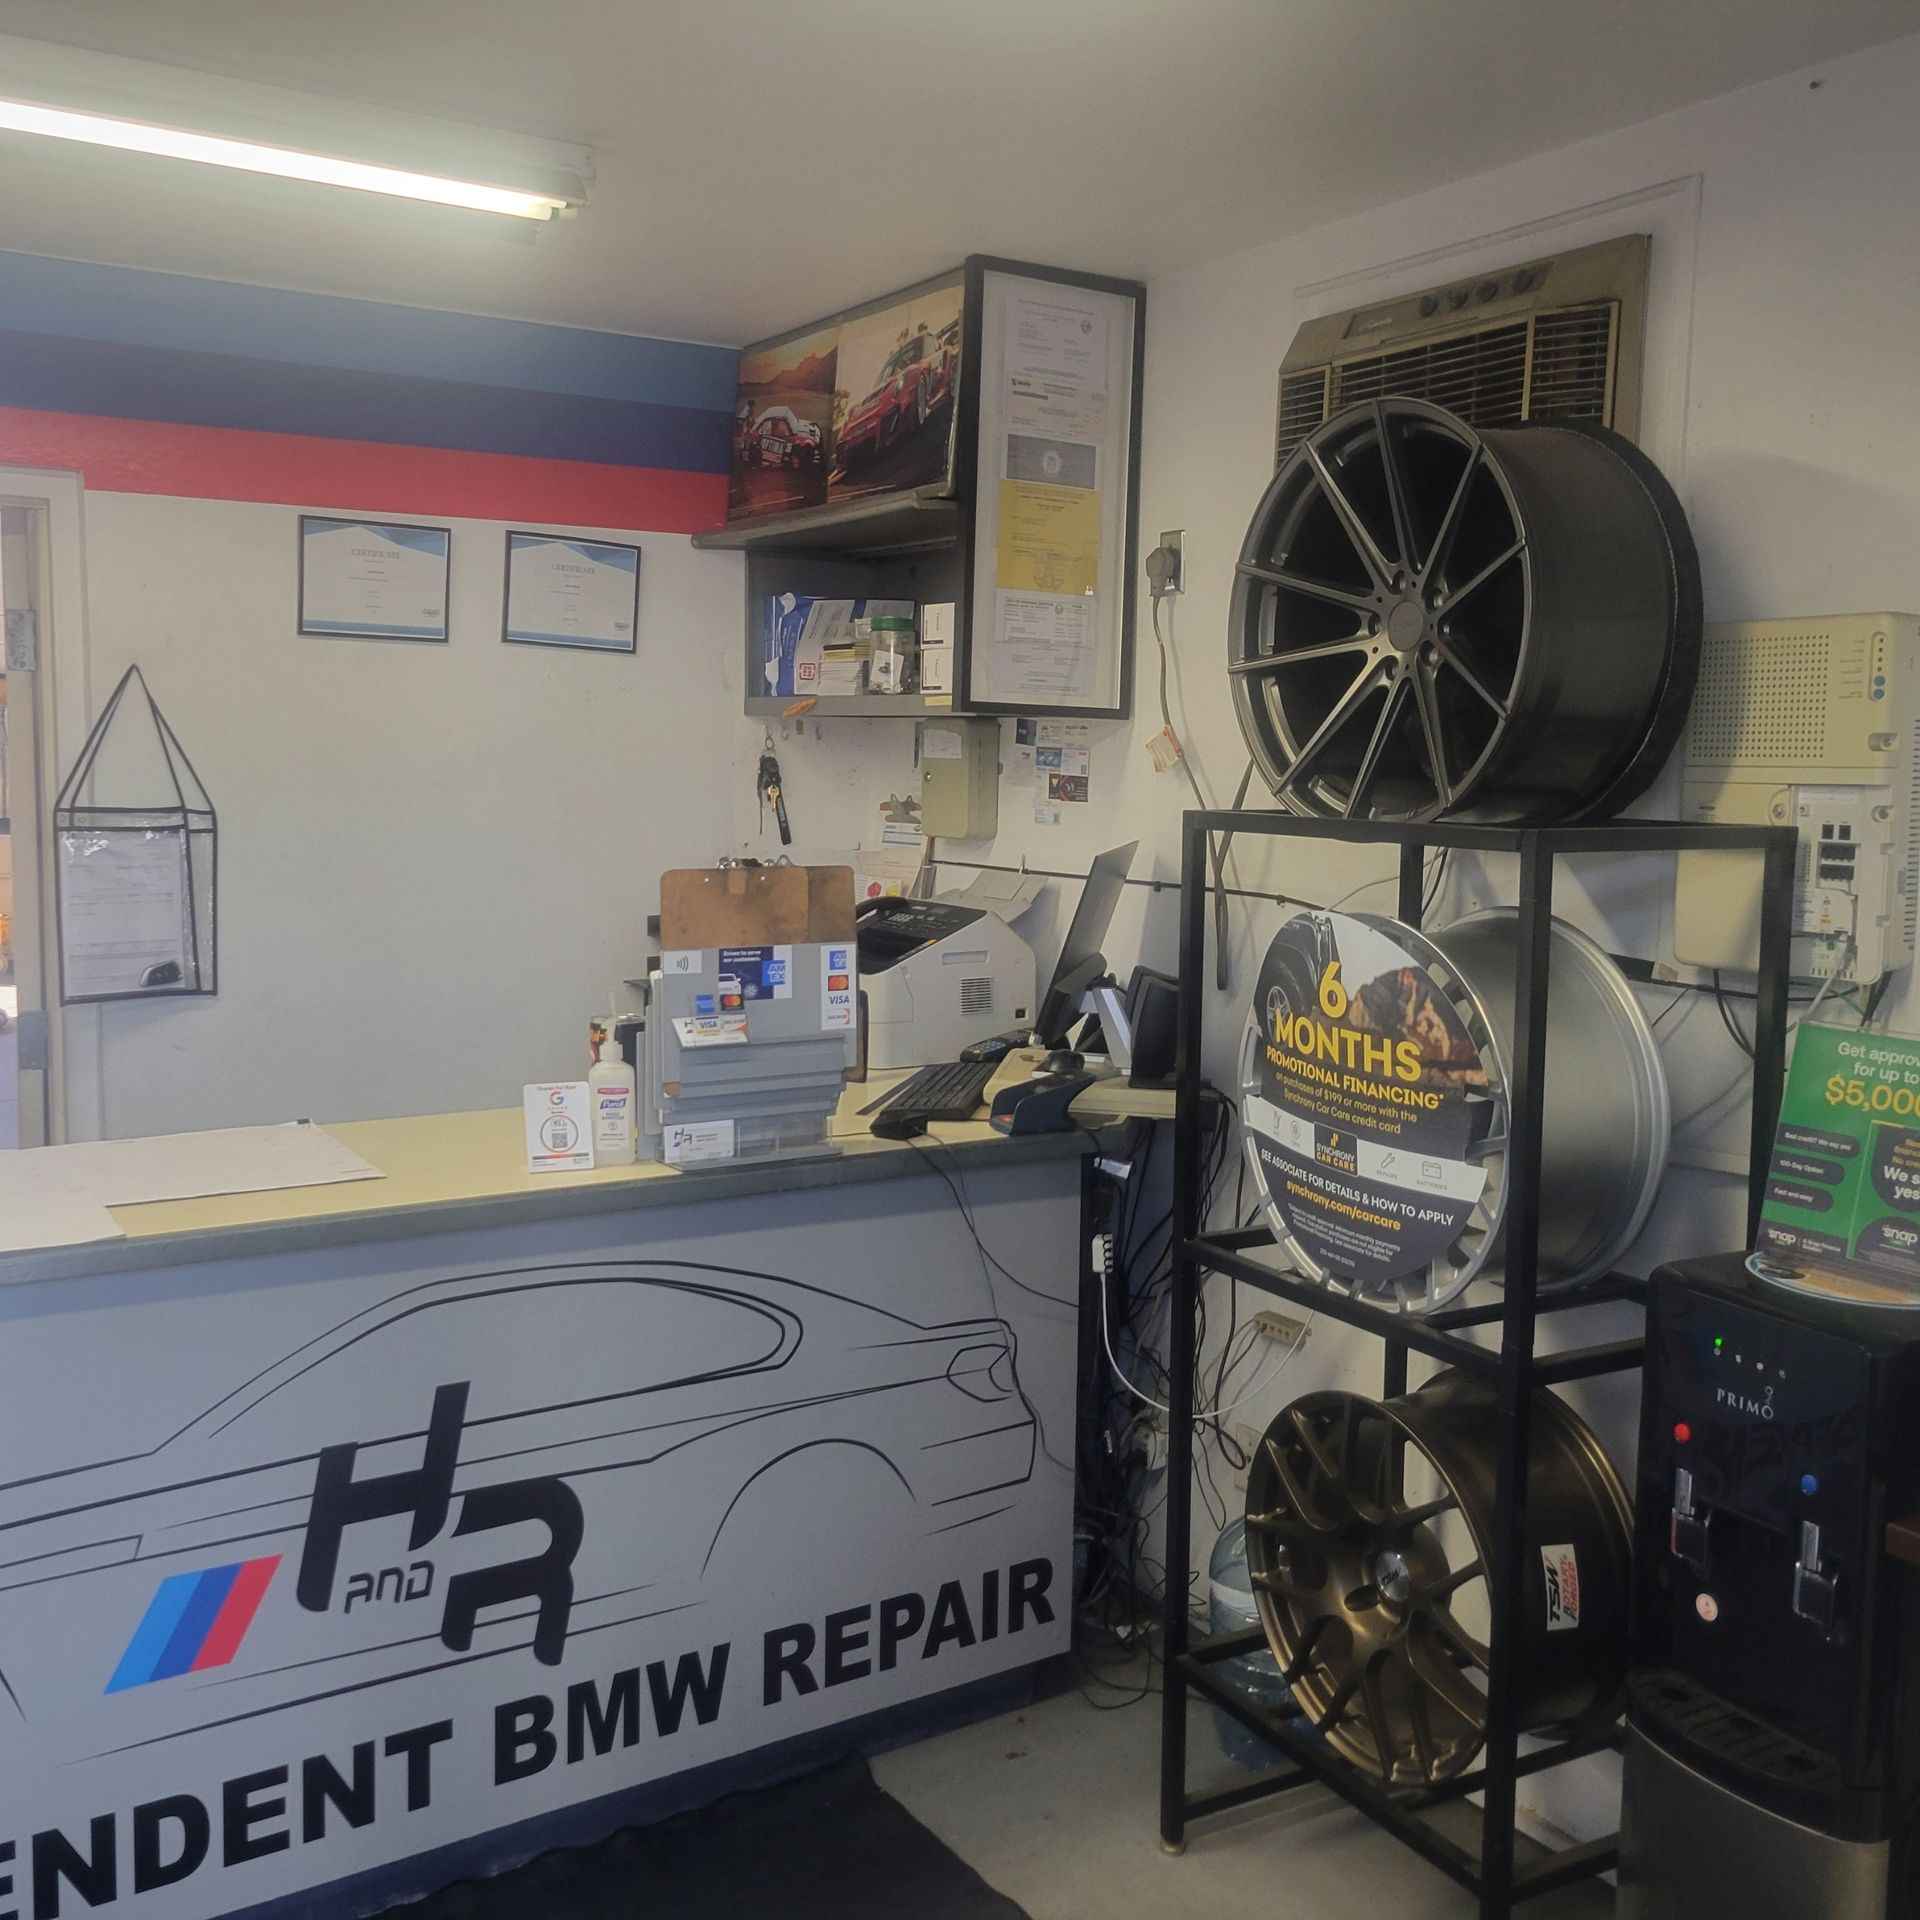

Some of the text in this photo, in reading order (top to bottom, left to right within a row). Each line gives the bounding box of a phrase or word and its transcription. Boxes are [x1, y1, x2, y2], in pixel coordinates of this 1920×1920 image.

[551, 563, 596, 575] CERTIFICATE
[768, 963, 785, 972] AM
[771, 973, 785, 982] EX
[829, 995, 849, 1004] VISA
[1319, 961, 1347, 1018] 6
[1275, 1007, 1421, 1082] MONTHS
[1838, 1042, 1866, 1057] Get
[1266, 1045, 1340, 1087] PROMOTIONAL
[1854, 1062, 1919, 1084] for up to
[1284, 1075, 1314, 1095] purchases
[1315, 1087, 1323, 1097] of
[1324, 1089, 1342, 1105] $199
[1344, 1097, 1353, 1106] or
[1354, 1100, 1377, 1114] more
[1378, 1106, 1398, 1118] with
[1400, 1109, 1417, 1123] the
[1284, 1088, 1400, 1134] Synchrony Car Care credit card
[1825, 1073, 1920, 1118] $5,00
[1316, 1143, 1356, 1162] SYNCHRONY
[1316, 1151, 1355, 1172] CAR CARE
[1261, 1148, 1454, 1226] SEE ASSOCIATE FOR DETAILS & HOW TO APPLY
[1883, 1165, 1908, 1182] We
[1287, 1180, 1401, 1231] synchrony.com/carcare
[1768, 1229, 1797, 1245] snap
[1882, 1225, 1918, 1245] snap
[1716, 1387, 1774, 1420] PRIMO
[296, 1380, 471, 1613] H
[440, 1476, 585, 1666] R
[1546, 1563, 1561, 1622] TSW
[0, 1556, 1056, 1920] NDENT BMW REPAIR
